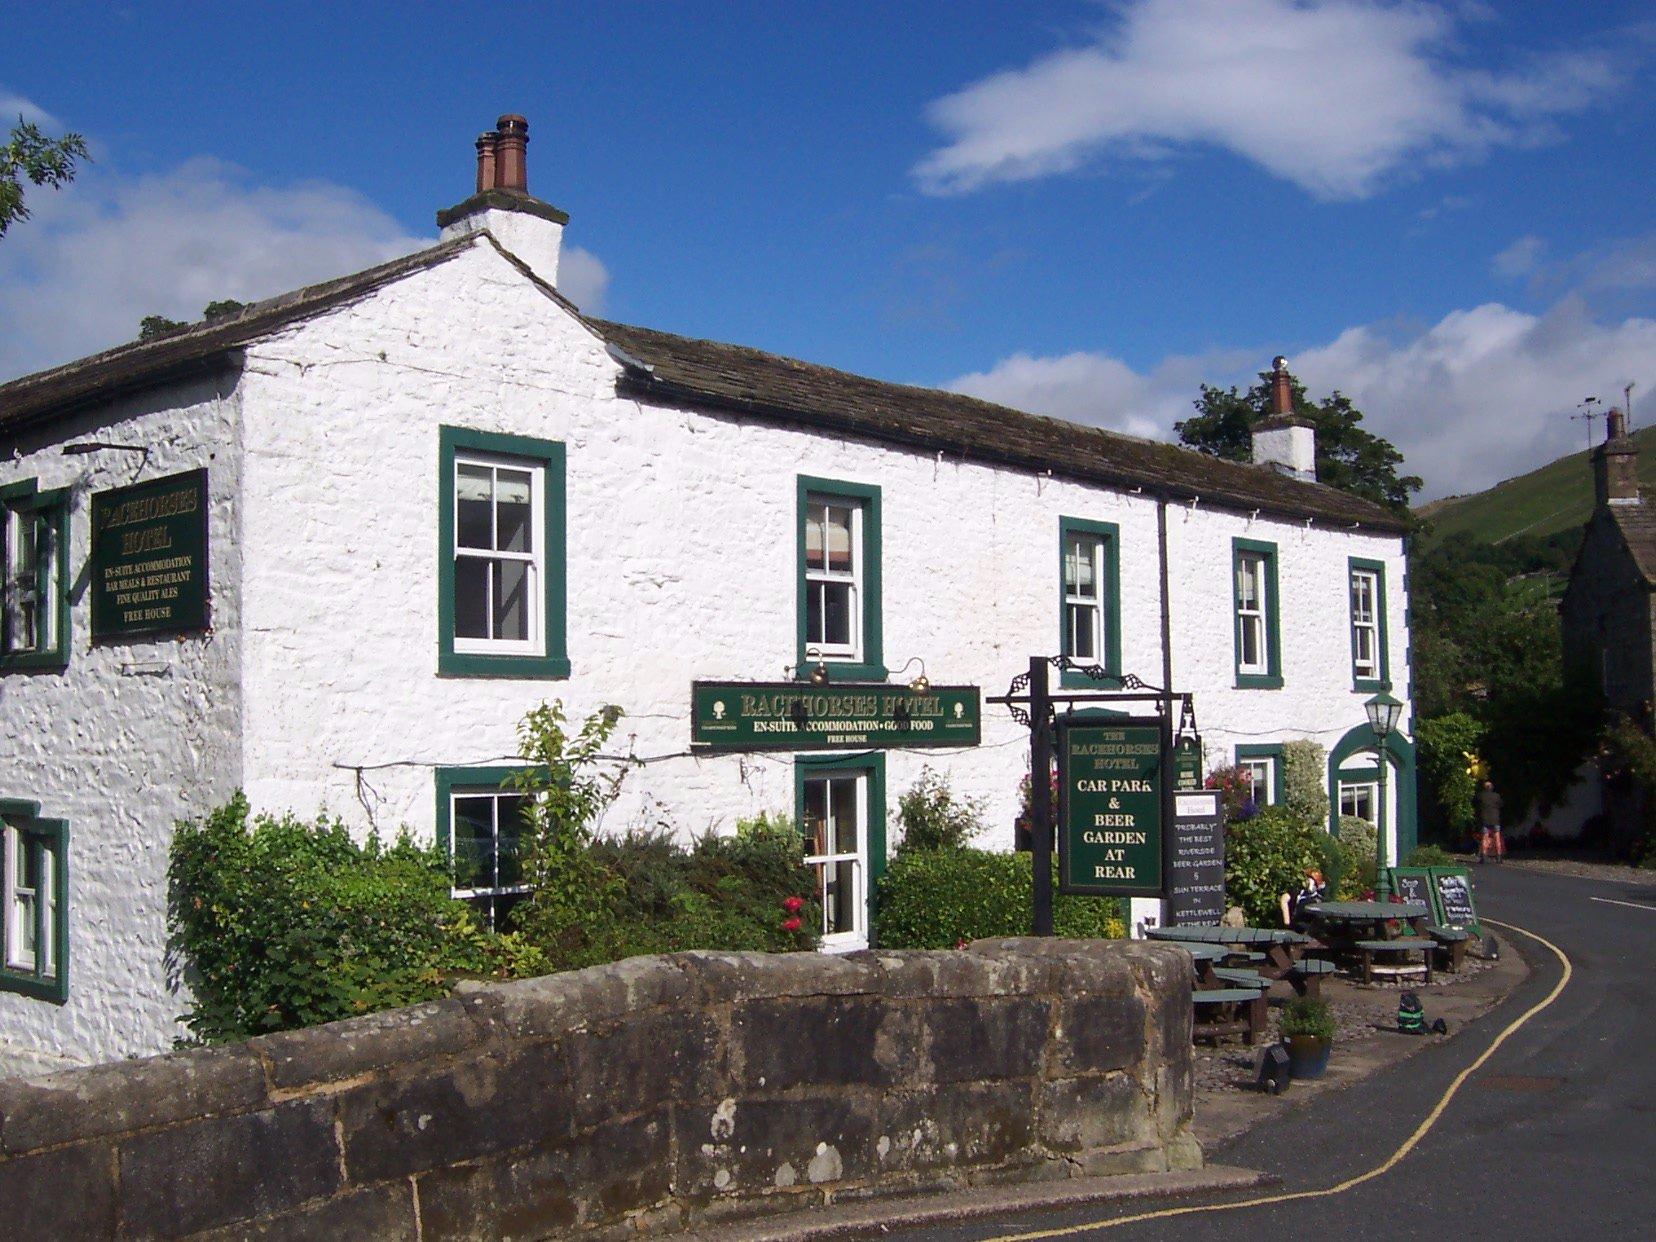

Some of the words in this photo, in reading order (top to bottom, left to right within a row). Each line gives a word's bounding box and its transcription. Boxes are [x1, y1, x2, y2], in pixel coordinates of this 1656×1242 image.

[121, 526, 172, 556] HOTEL
[104, 564, 134, 578] EN-SUITE
[135, 556, 192, 573] ACCOMMODATION
[106, 581, 118, 592] BAR
[119, 578, 140, 590] MEALS
[141, 578, 146, 587] &
[147, 570, 191, 586] RESTAURANT
[117, 593, 131, 605] FINE
[132, 590, 160, 604] QUALITY
[161, 587, 178, 599] ALES
[124, 610, 143, 623] FREE
[145, 607, 171, 620] HOUSE
[754, 721, 798, 732] EN-SUITE
[800, 720, 879, 732] ACCOMMODATION
[910, 720, 934, 731] FOOD
[827, 735, 845, 743] FREE
[846, 734, 868, 743] HOUSE
[1103, 732, 1125, 740] THE
[1071, 744, 1159, 755] RACEHORSES
[1094, 758, 1139, 770] HOTEL
[1077, 779, 1107, 792] CAR
[1111, 779, 1152, 792] PARK
[1108, 797, 1120, 809] &
[1094, 814, 1135, 827] BEER
[1083, 832, 1147, 844] GARDEN
[1104, 849, 1125, 861] AT
[1192, 860, 1223, 868] GARDEN
[1094, 866, 1136, 879] REAR
[1174, 886, 1189, 894] SUN
[1176, 909, 1221, 917] KETTLEWELL
